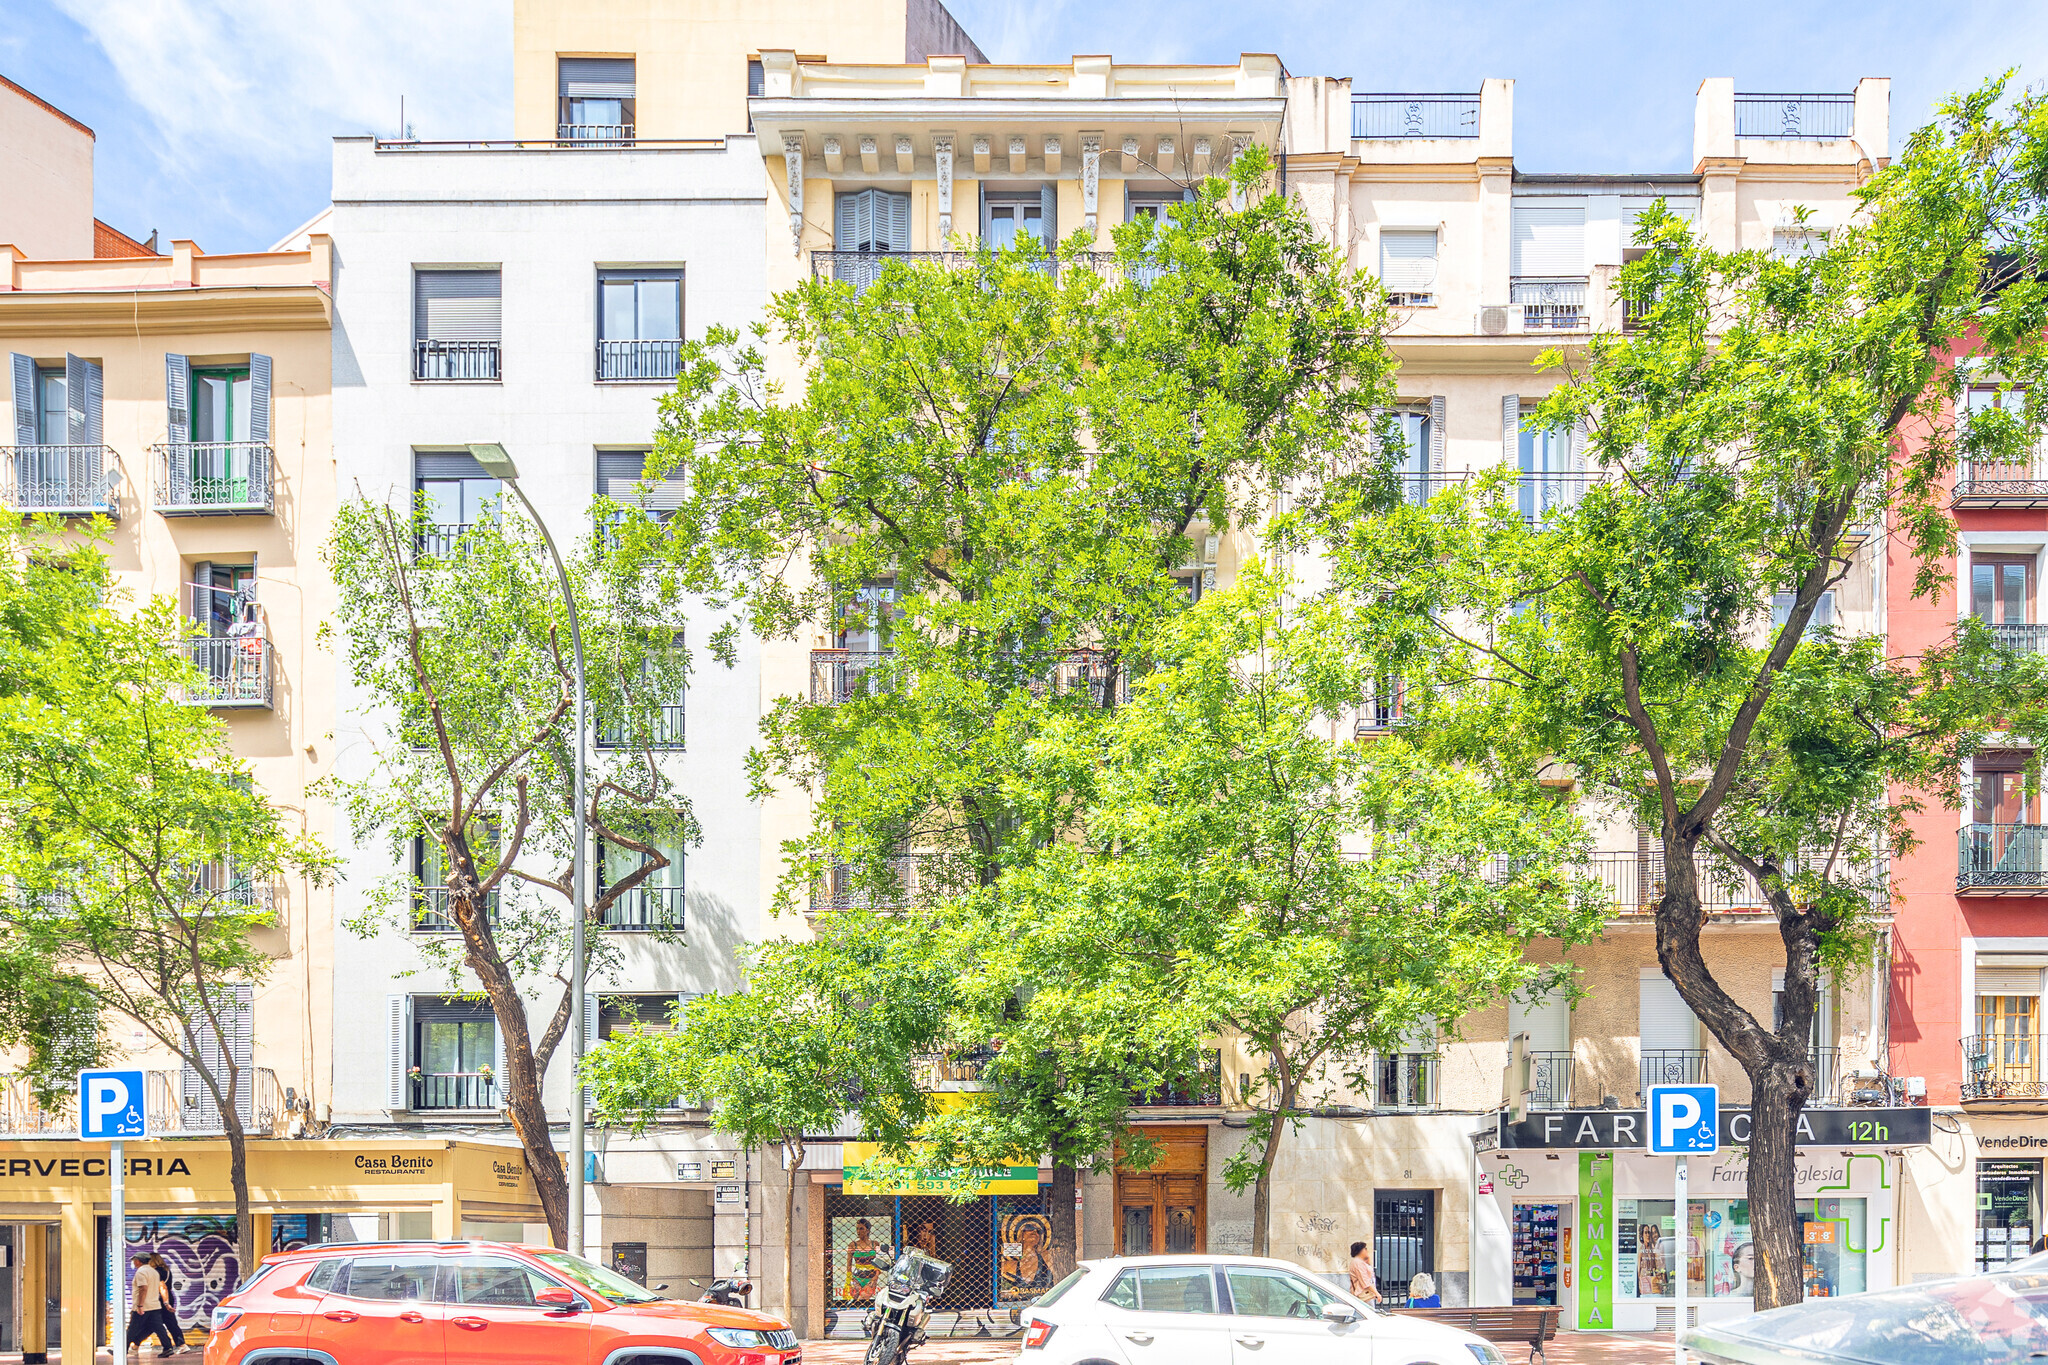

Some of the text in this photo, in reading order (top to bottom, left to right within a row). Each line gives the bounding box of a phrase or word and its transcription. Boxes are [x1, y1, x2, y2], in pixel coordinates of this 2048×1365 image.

[89, 1078, 129, 1132] P
[1544, 1113, 1889, 1143] FARCA 12h
[1660, 1094, 1701, 1147] P
[117, 1124, 125, 1134] 2
[1688, 1138, 1696, 1148] 2
[0, 1158, 191, 1176] RVECRIA
[354, 1155, 434, 1169] Casa Benito
[492, 1161, 523, 1175] Casa Benito
[1404, 1169, 1412, 1179] 81
[1796, 1165, 1843, 1184] glesia
[916, 1180, 945, 1190] 593
[1587, 1160, 1604, 1324] FARMACIA
